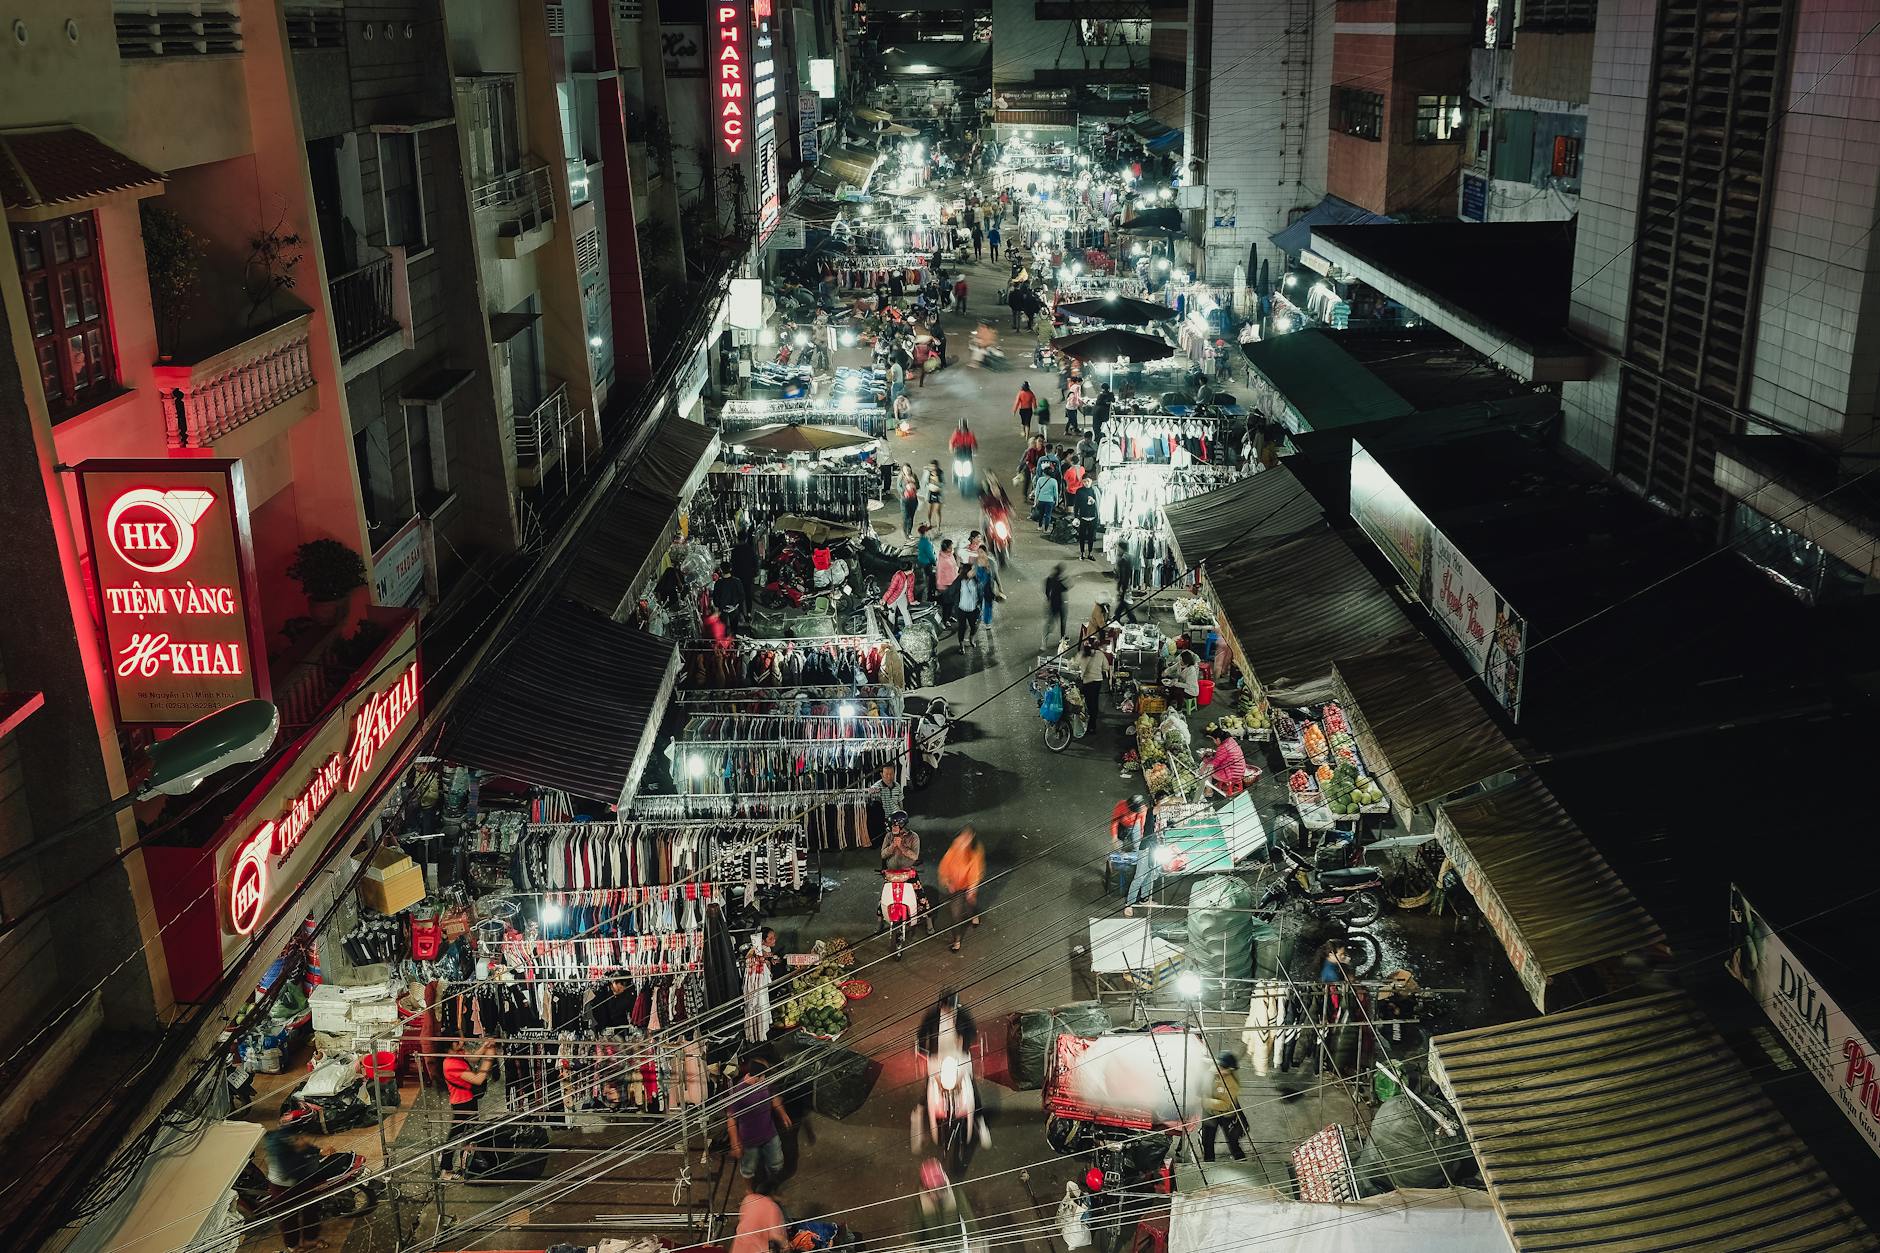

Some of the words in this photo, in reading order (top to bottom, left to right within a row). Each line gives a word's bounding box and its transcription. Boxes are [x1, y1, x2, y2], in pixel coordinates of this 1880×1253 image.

[719, 8, 742, 153] PHARMACY
[120, 522, 171, 550] HK
[106, 580, 167, 620] TIỆM
[169, 580, 235, 615] VÀNG
[278, 793, 310, 855] TIỆM
[309, 754, 342, 811] VÀNG
[236, 877, 257, 921] HK
[1779, 953, 1831, 1047] DỪA
[1838, 1085, 1858, 1118] Nhận
[1859, 1111, 1877, 1142] Giao
